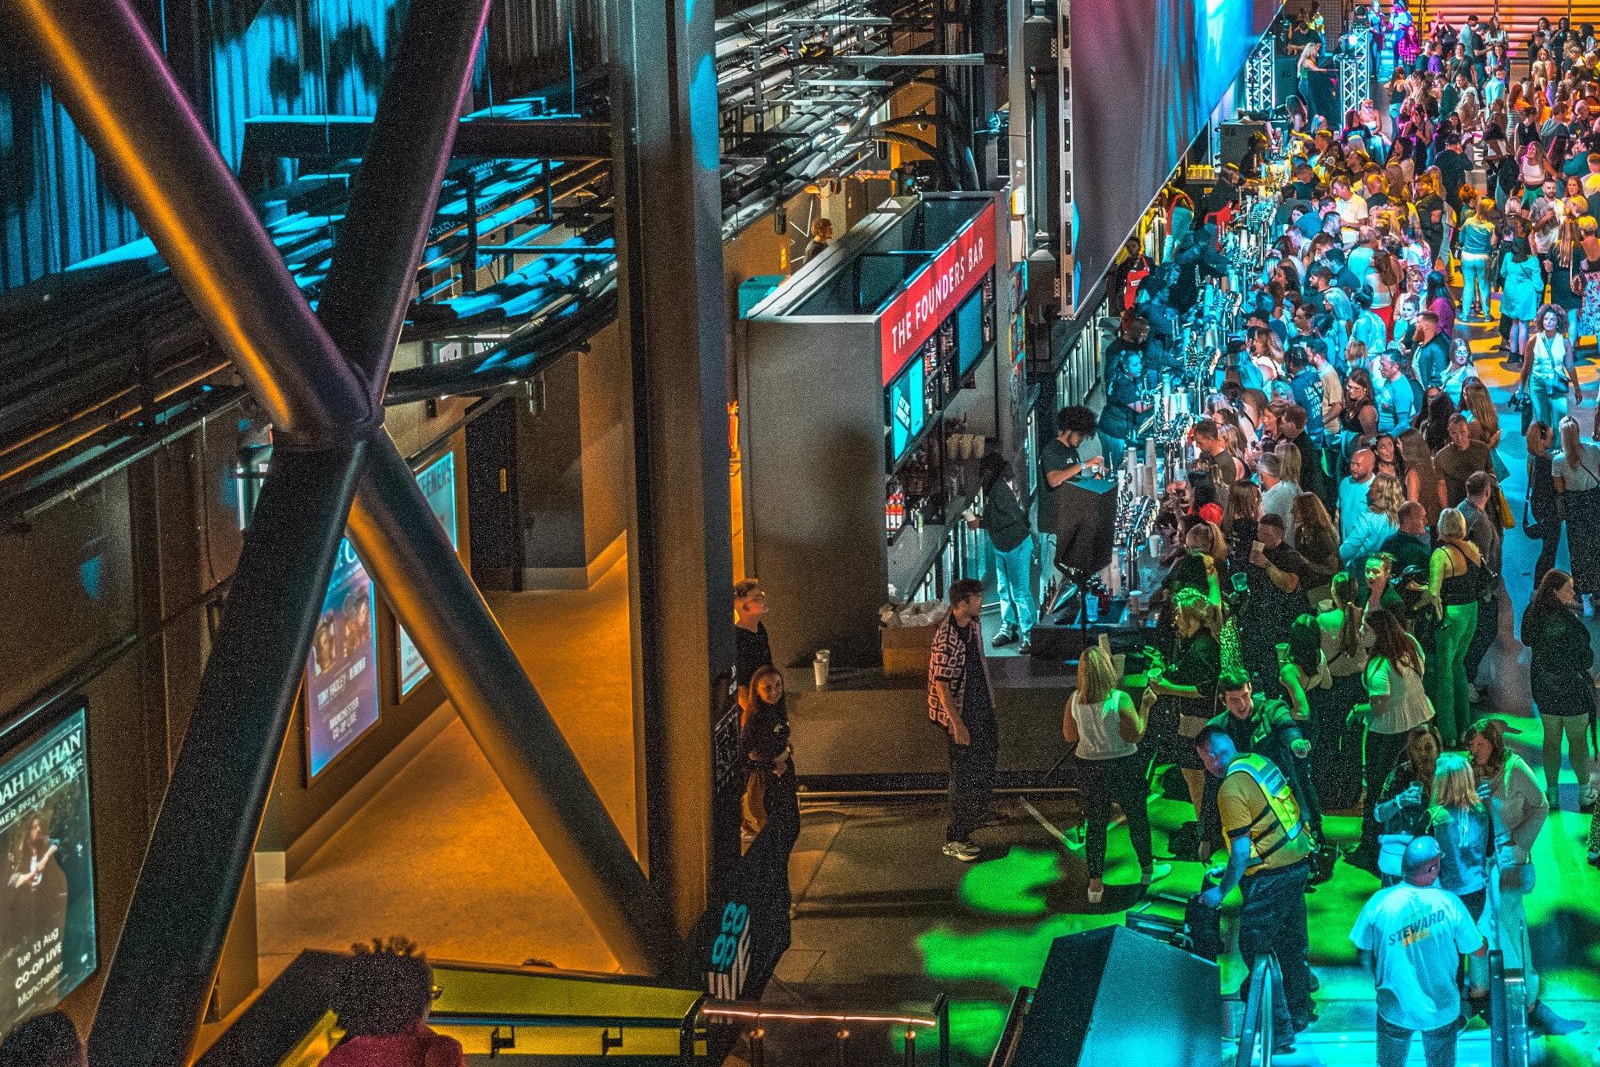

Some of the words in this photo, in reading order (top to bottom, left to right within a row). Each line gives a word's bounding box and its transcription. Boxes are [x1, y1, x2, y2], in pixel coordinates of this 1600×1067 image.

[891, 309, 912, 354] THE
[914, 257, 965, 330] FOUNDERS
[968, 237, 984, 271] BAR
[27, 730, 81, 785] KAHAN
[17, 952, 31, 968] Tue
[33, 940, 42, 954] 13
[43, 927, 59, 947] Aug
[1388, 909, 1445, 946] STEWARD
[15, 957, 45, 989] CO-OP
[46, 941, 62, 963] LIVE
[17, 961, 64, 1008] Manchester
